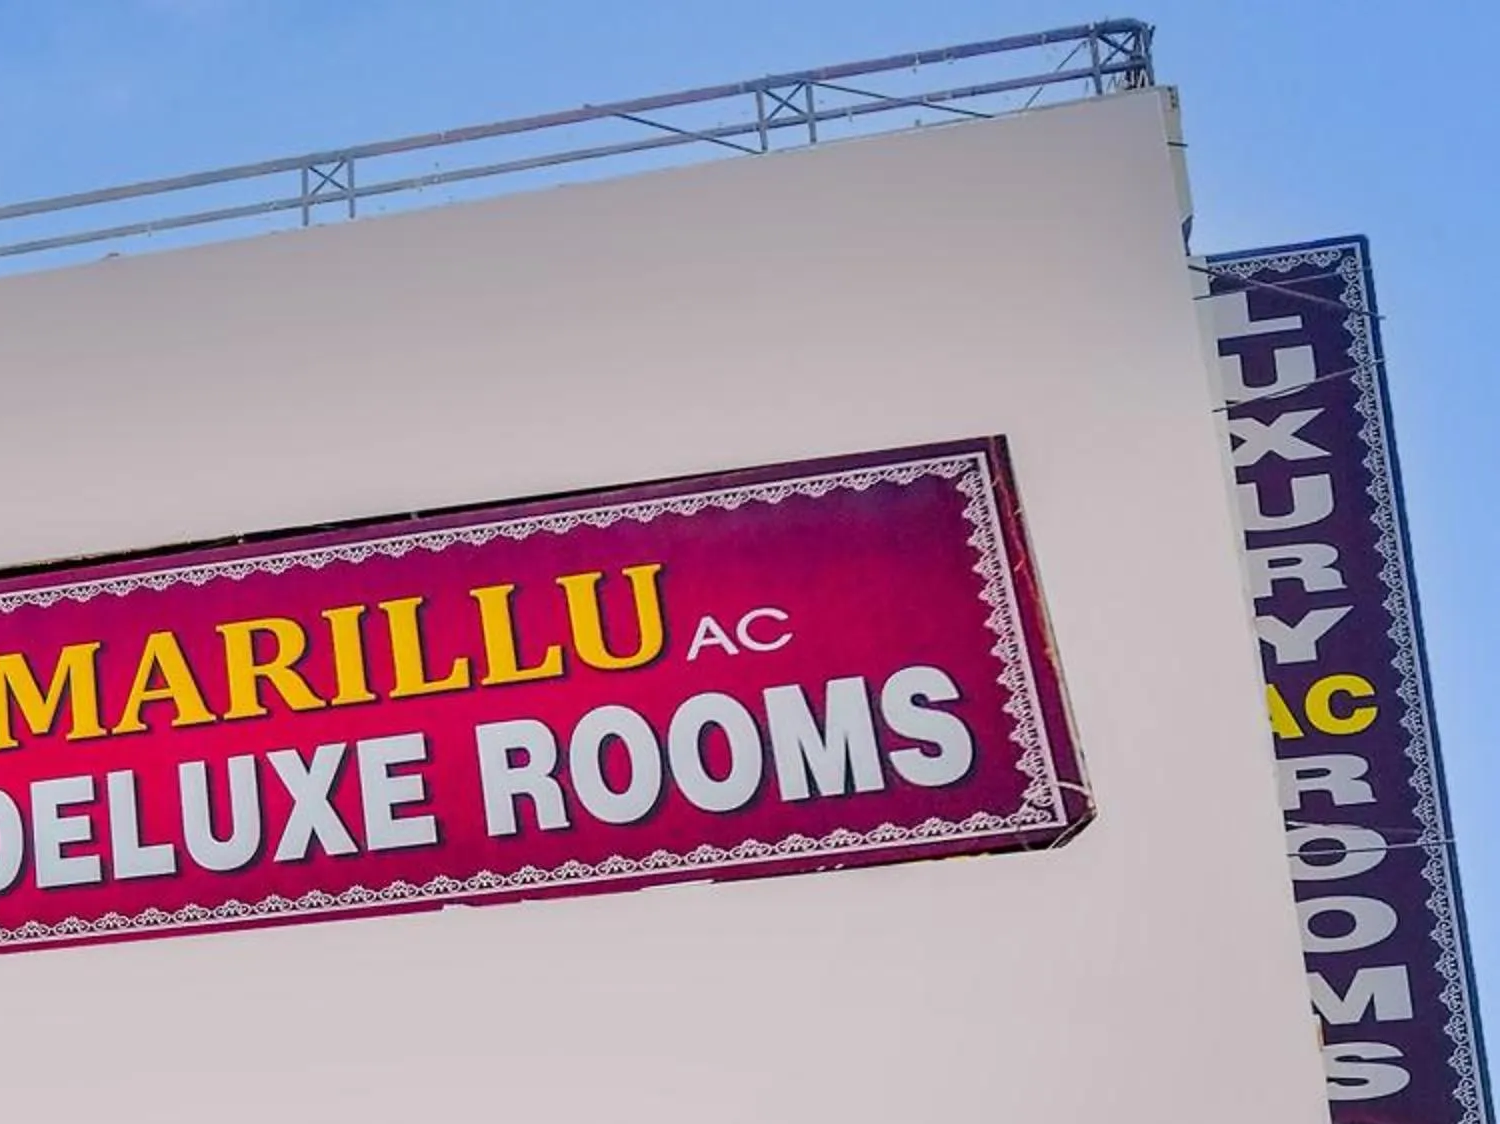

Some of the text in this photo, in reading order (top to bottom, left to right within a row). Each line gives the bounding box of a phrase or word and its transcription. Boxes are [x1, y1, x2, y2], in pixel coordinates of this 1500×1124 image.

[1210, 290, 1353, 665] LUXURY
[475, 664, 976, 837] ROOMS
[685, 607, 794, 661] AC
[1277, 752, 1414, 1101] ROOMS
